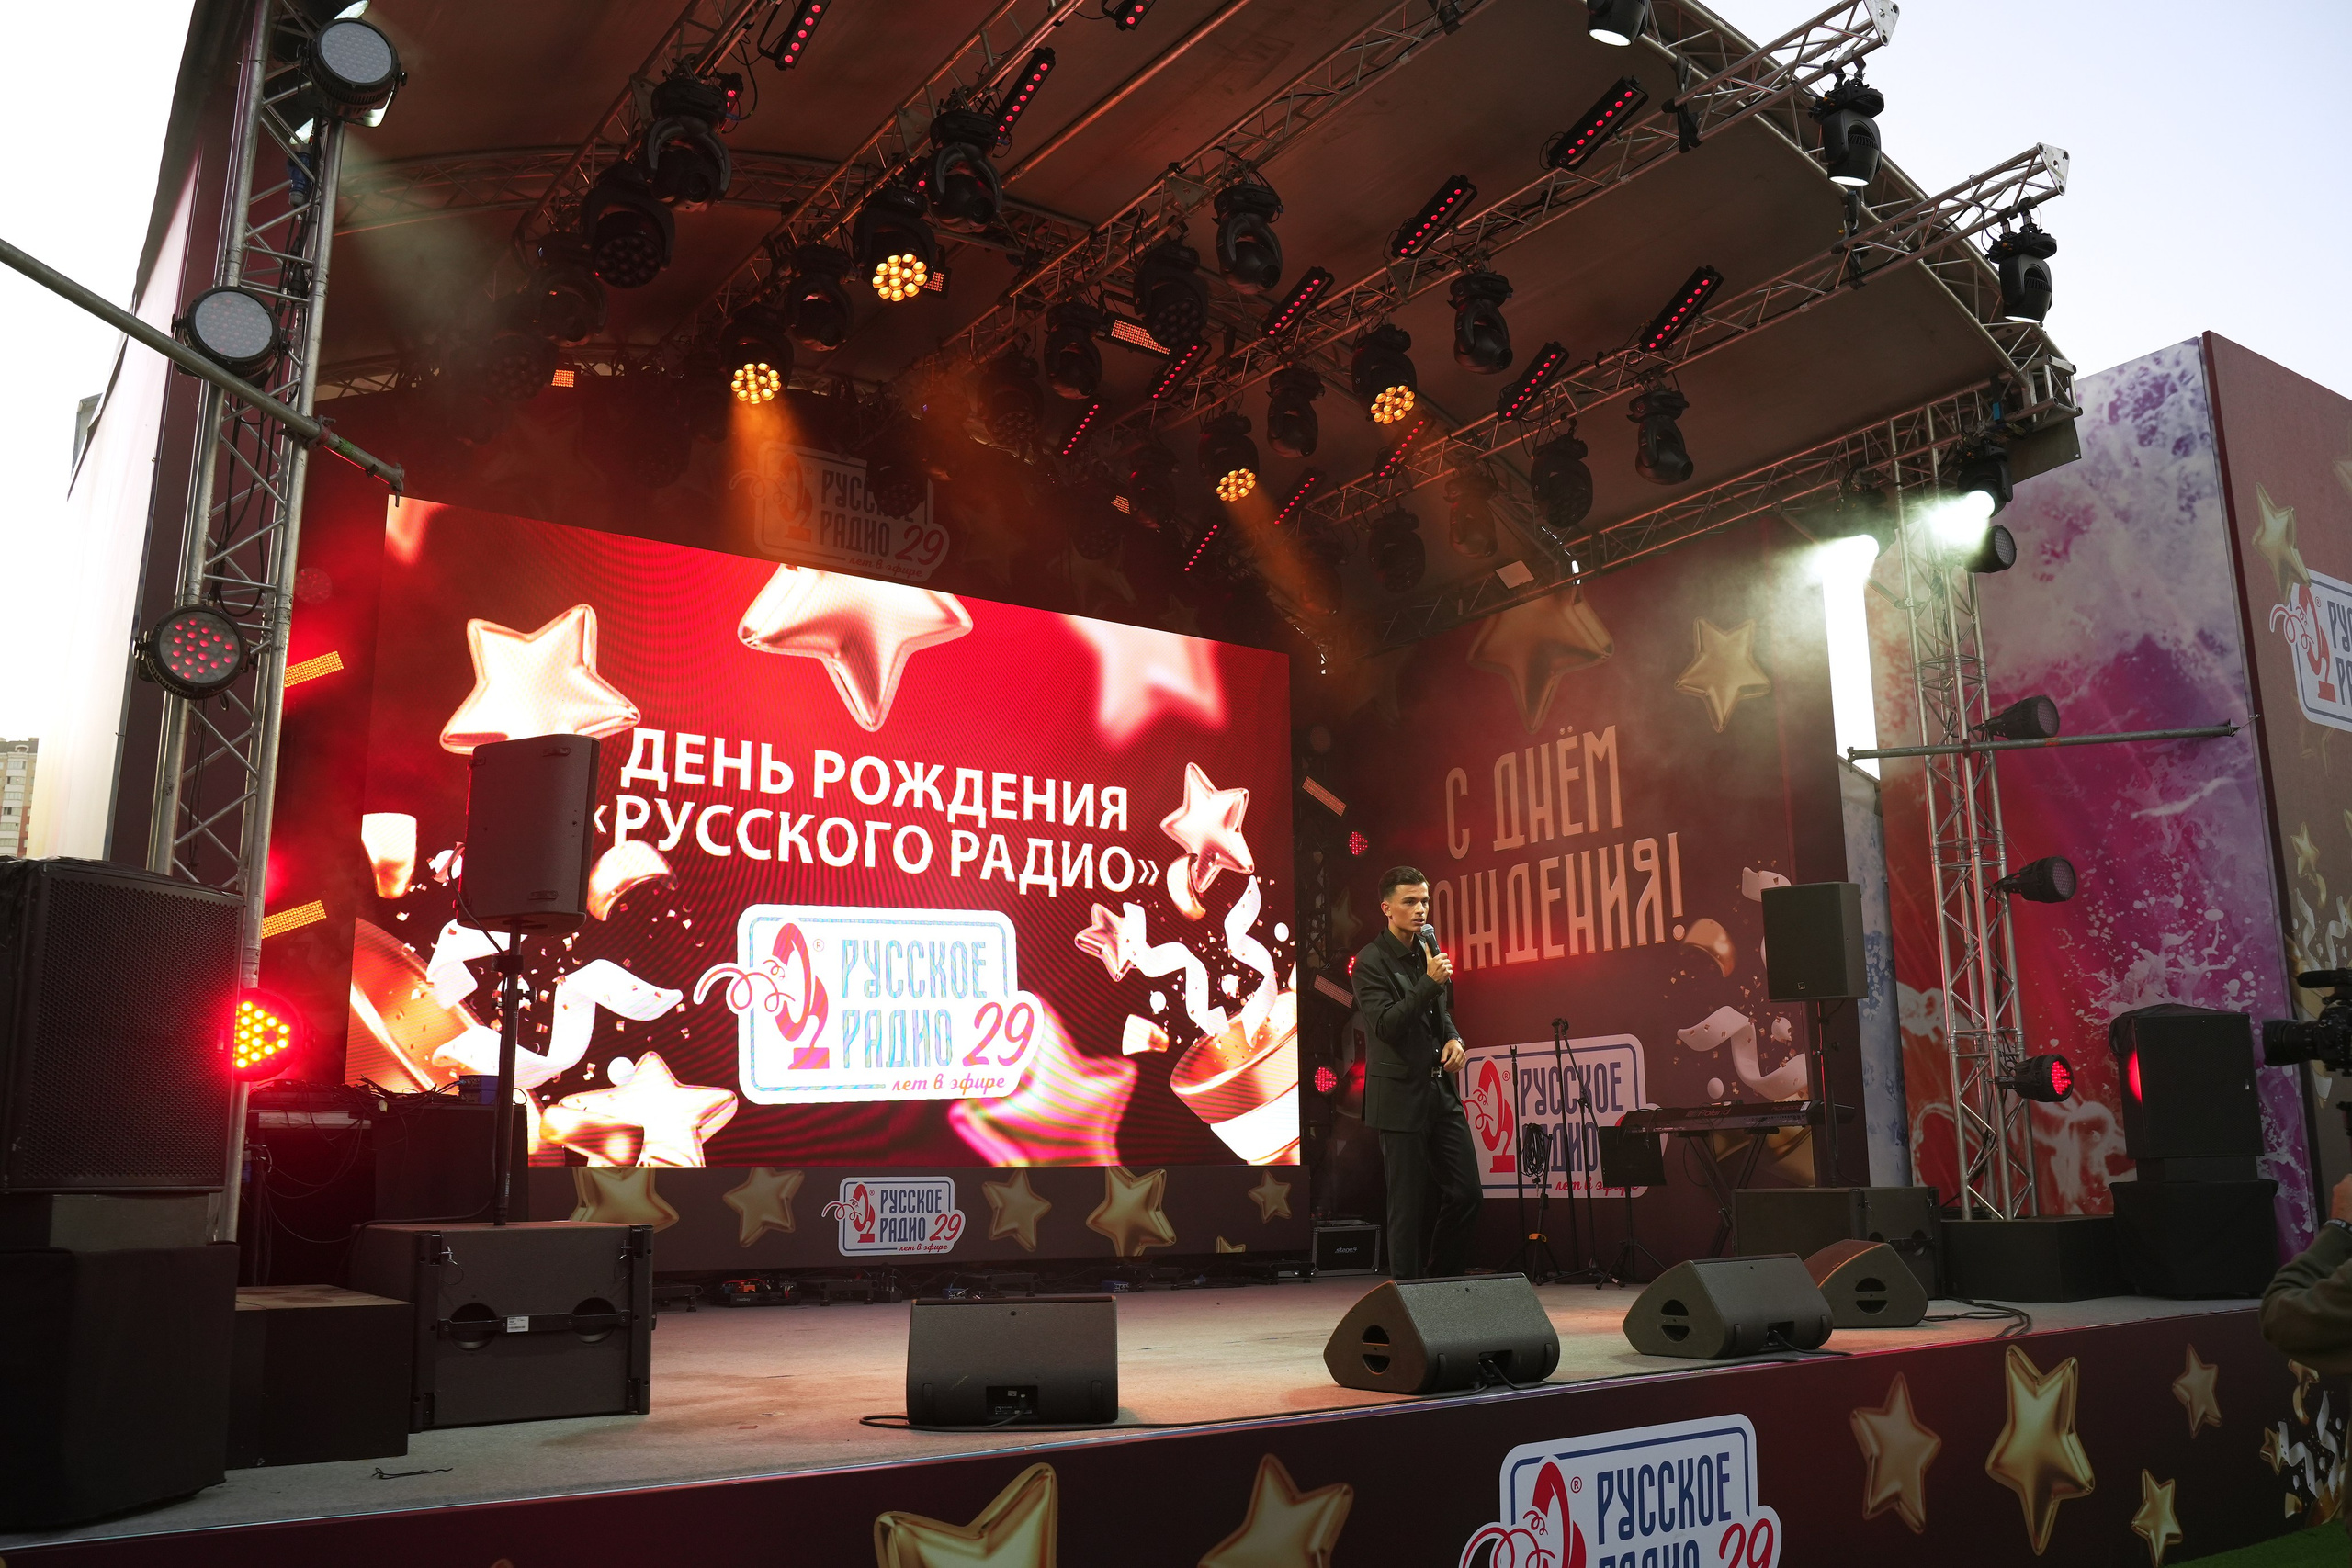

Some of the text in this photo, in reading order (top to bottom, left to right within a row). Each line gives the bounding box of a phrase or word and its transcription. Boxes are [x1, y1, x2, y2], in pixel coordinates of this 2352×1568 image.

[820, 510, 945, 566] РАДИО 29
[848, 557, 923, 579] лет в эфире
[620, 727, 1128, 831] ДЕНЬ РОЖДЕНИЯ
[1445, 724, 1623, 860] С ДНЁМ
[950, 830, 1159, 897] РАДИО»
[1432, 831, 1684, 972] ОЖДЕНИЯ!
[842, 940, 988, 999] РУССКОЕ
[842, 1001, 1035, 1069] РАДИО 29
[891, 1072, 1007, 1096] лет в эфире
[1520, 1061, 1623, 1117] РУССКОЕ
[879, 1213, 962, 1243] РАДИО 29
[880, 1189, 943, 1214] РУССКОЕ
[917, 1243, 922, 1251] в
[923, 1243, 948, 1252] эфире
[1597, 1451, 1732, 1546] РУССКОЕ
